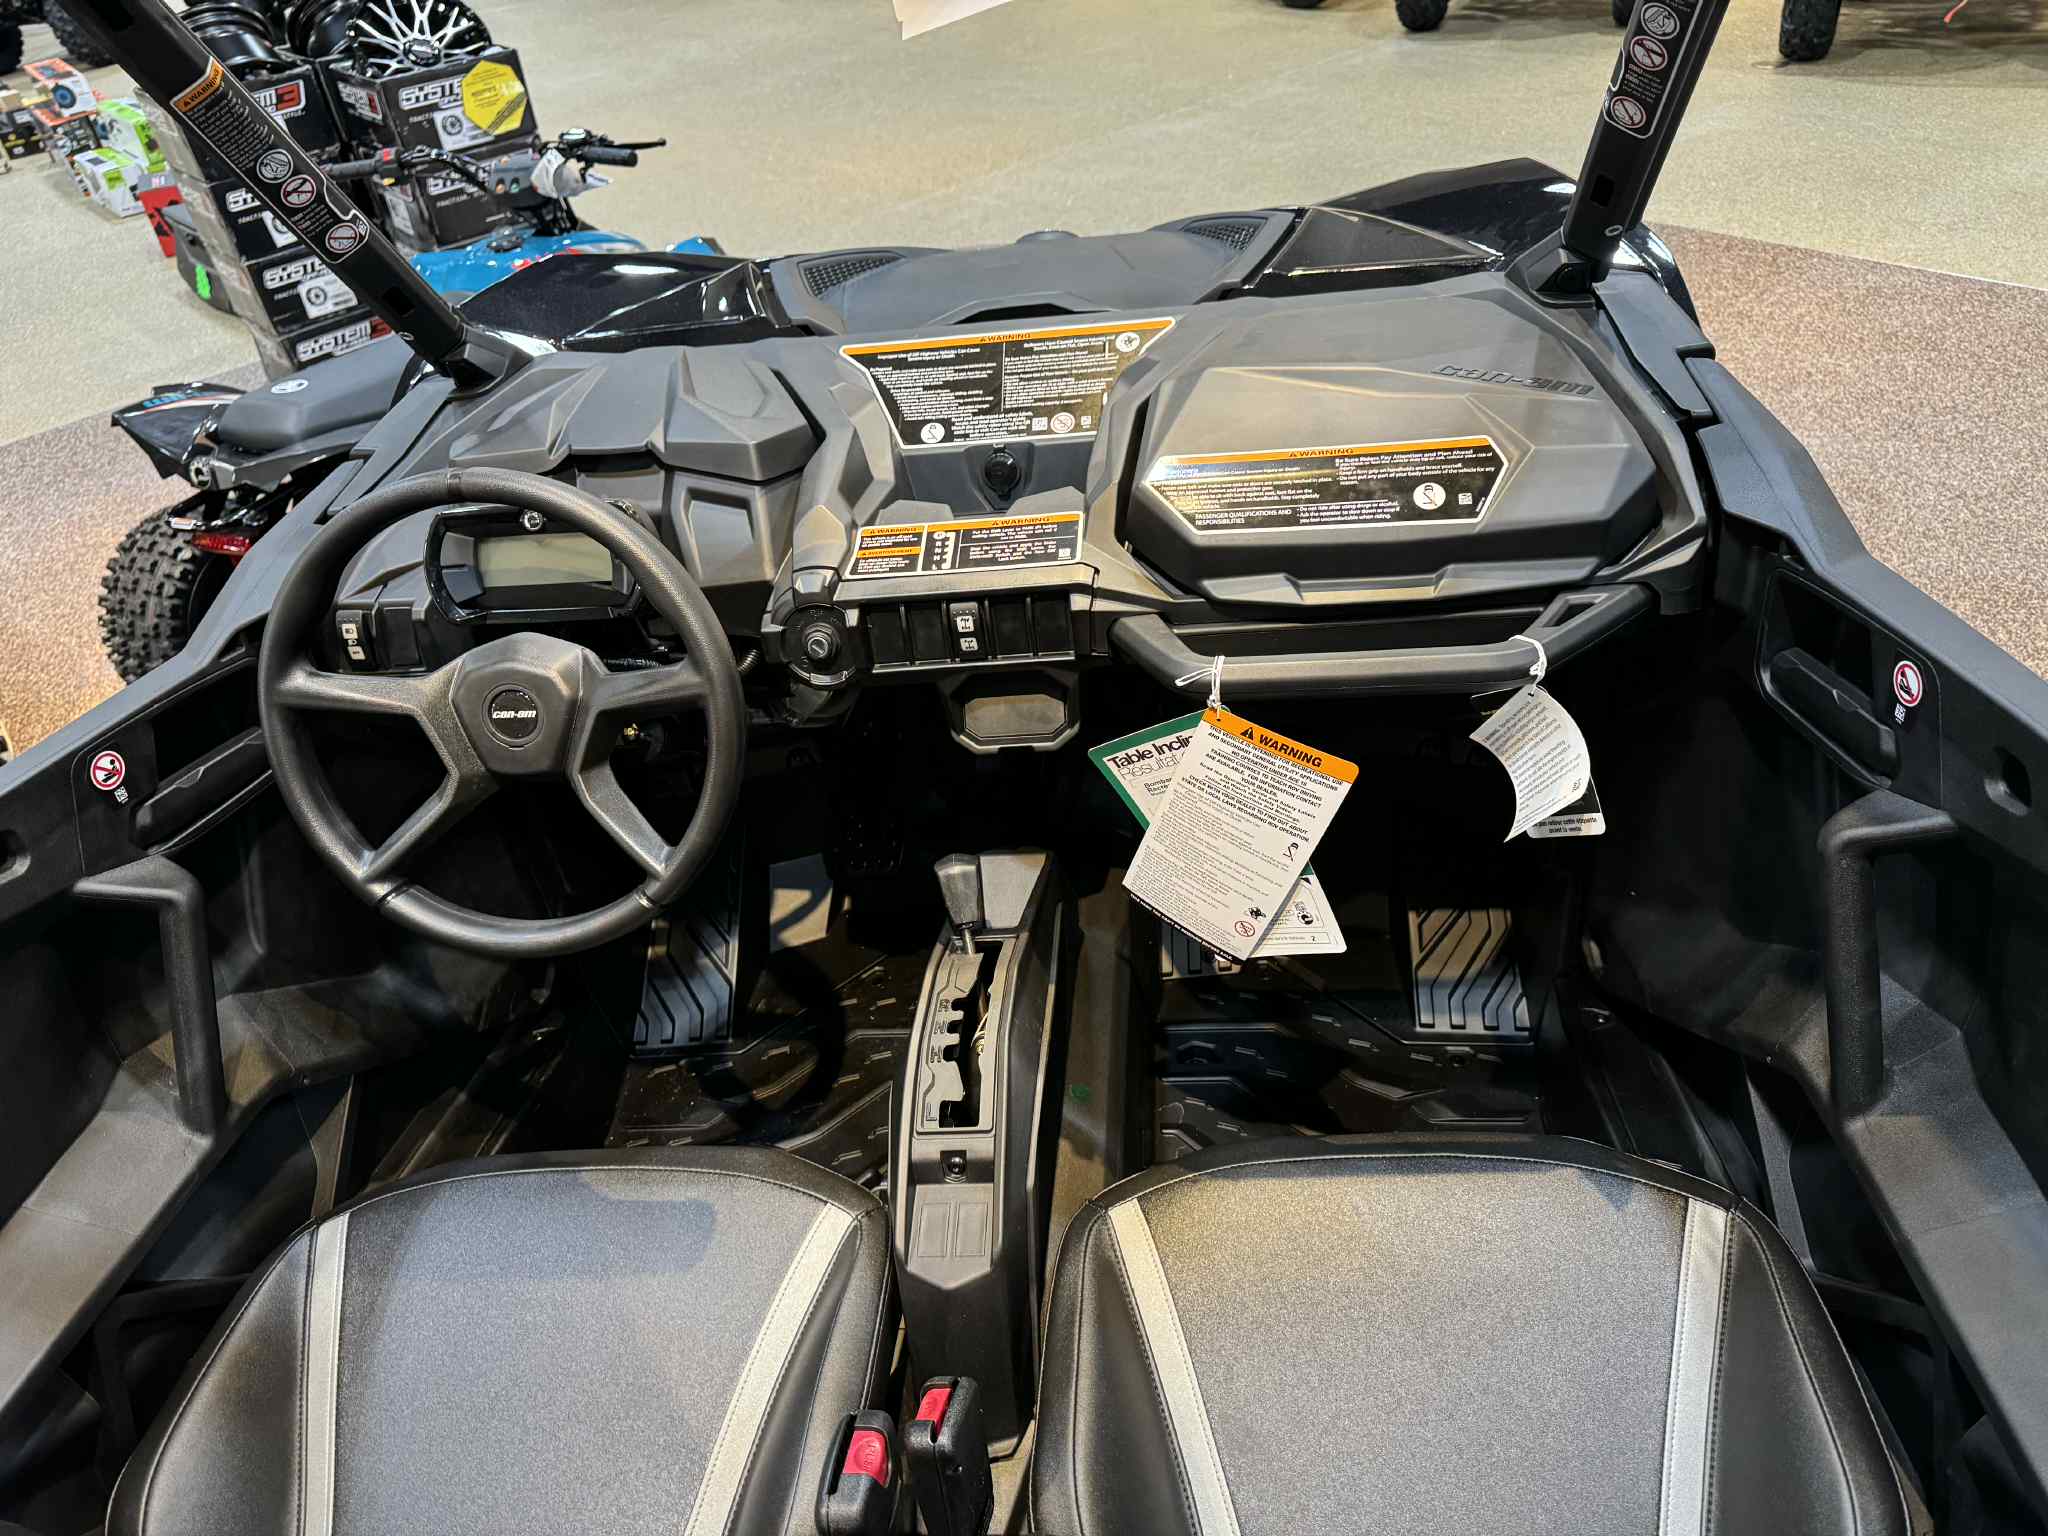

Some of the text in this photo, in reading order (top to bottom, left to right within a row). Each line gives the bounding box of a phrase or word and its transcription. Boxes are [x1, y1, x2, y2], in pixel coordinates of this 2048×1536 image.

[988, 333, 1031, 342] WARNING
[1300, 449, 1354, 457] WARNING
[1001, 517, 1050, 525] WARNING
[1196, 517, 1245, 526] RESPONSIBILITIES
[1229, 509, 1278, 518] QUALIFICATIONS
[492, 710, 537, 719] can-am
[1107, 746, 1154, 770] Table
[1207, 730, 1338, 792] AND SECONDARY GENERAL UTILITY APPLICATIONS
[1221, 730, 1245, 745] VEHICLE
[1278, 756, 1290, 765] FOR
[1331, 778, 1343, 786] USE
[1259, 734, 1323, 768] WARNING
[1204, 752, 1216, 761] ARE
[1247, 773, 1259, 781] FOR
[1258, 778, 1295, 798] INFORMATION
[1295, 794, 1321, 808] CONTACT
[1209, 747, 1236, 764] TRAINING
[1234, 760, 1261, 776] COURSES
[1269, 776, 1287, 787] TEACH
[1299, 789, 1322, 802] DRIVING
[1230, 749, 1300, 784] NO OPERATOR UNDER AGE
[1199, 761, 1213, 771] Read
[1251, 787, 1268, 798] Guide
[1267, 795, 1279, 803] and
[1278, 800, 1296, 811] Safety
[1239, 776, 1256, 787] YOUR
[1180, 776, 1197, 788] STATE
[1196, 784, 1205, 792] OR
[1204, 789, 1221, 801] LOCAL
[1220, 797, 1237, 809] LAWS
[1236, 805, 1267, 823] REGARDING
[1188, 774, 1207, 786] CHECK
[1206, 783, 1221, 794] WITH
[1220, 790, 1236, 801] YOUR
[1235, 798, 1256, 811] DEALER
[1263, 811, 1277, 821] FIND
[1276, 817, 1289, 826] OUT
[1288, 823, 1308, 835] ABOUT
[926, 1103, 938, 1121] L
